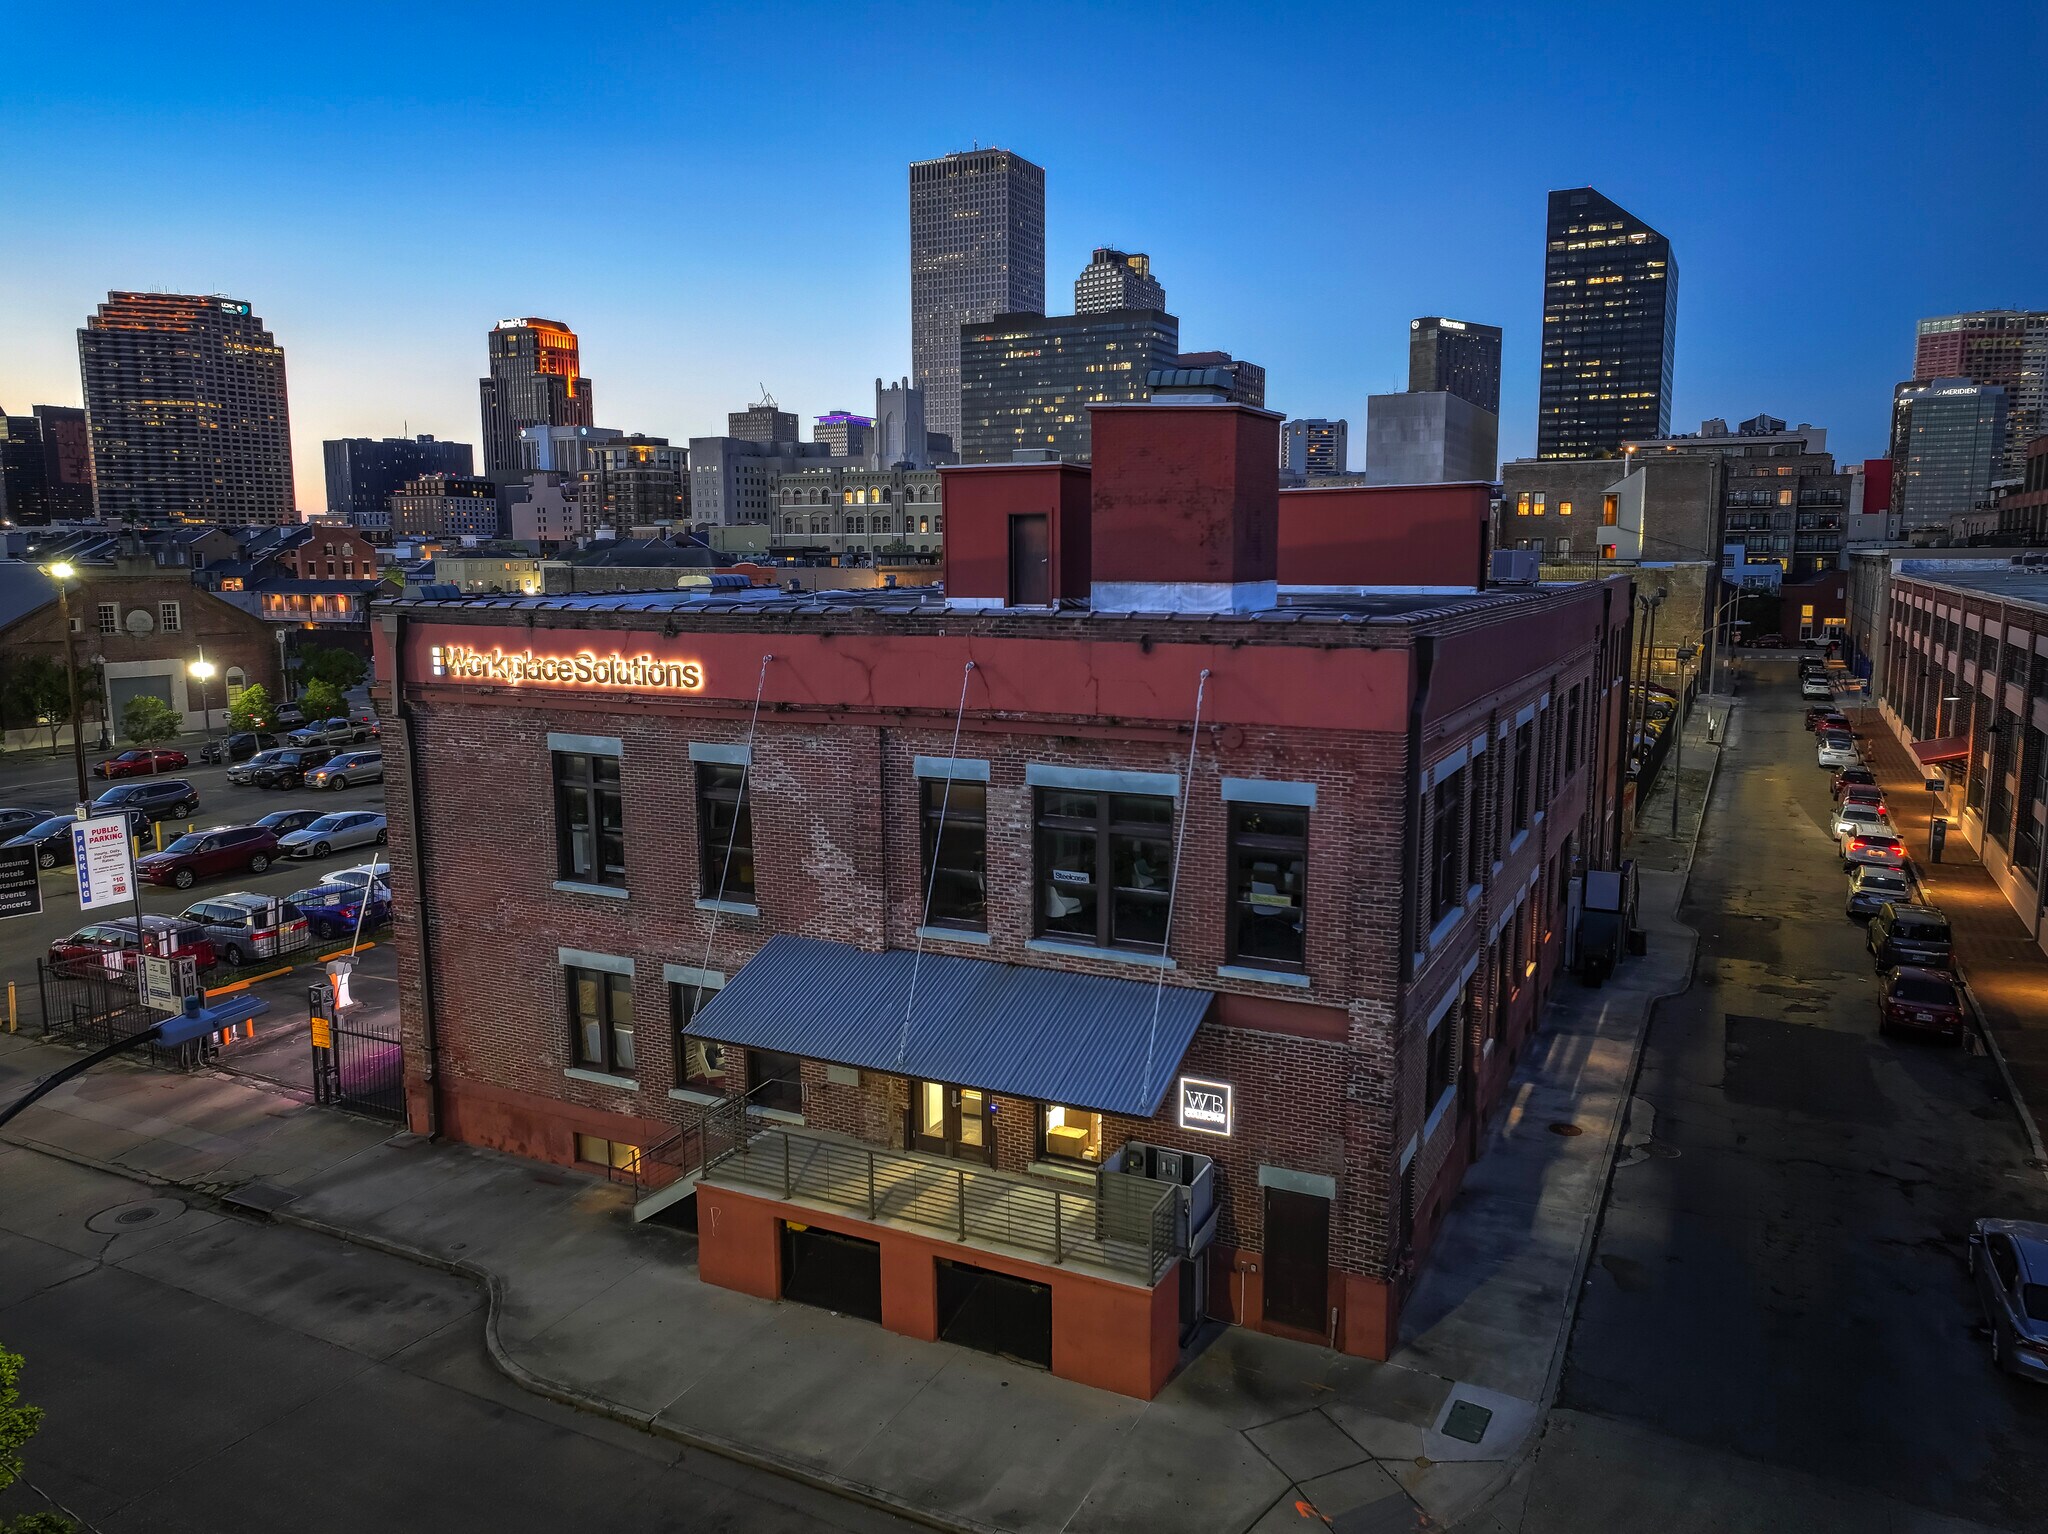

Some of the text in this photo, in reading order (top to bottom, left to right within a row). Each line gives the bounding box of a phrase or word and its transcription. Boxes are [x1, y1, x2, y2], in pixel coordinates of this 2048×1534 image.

[91, 825, 119, 835] PUBLIC
[89, 832, 123, 843] PARKING
[0, 859, 30, 868] useums
[77, 835, 90, 897] PARKING
[0, 870, 25, 878] Hotels
[0, 891, 27, 900] Events
[0, 901, 32, 910] oncerts
[139, 957, 149, 1004] PARKING
[1185, 1090, 1224, 1113] WB
